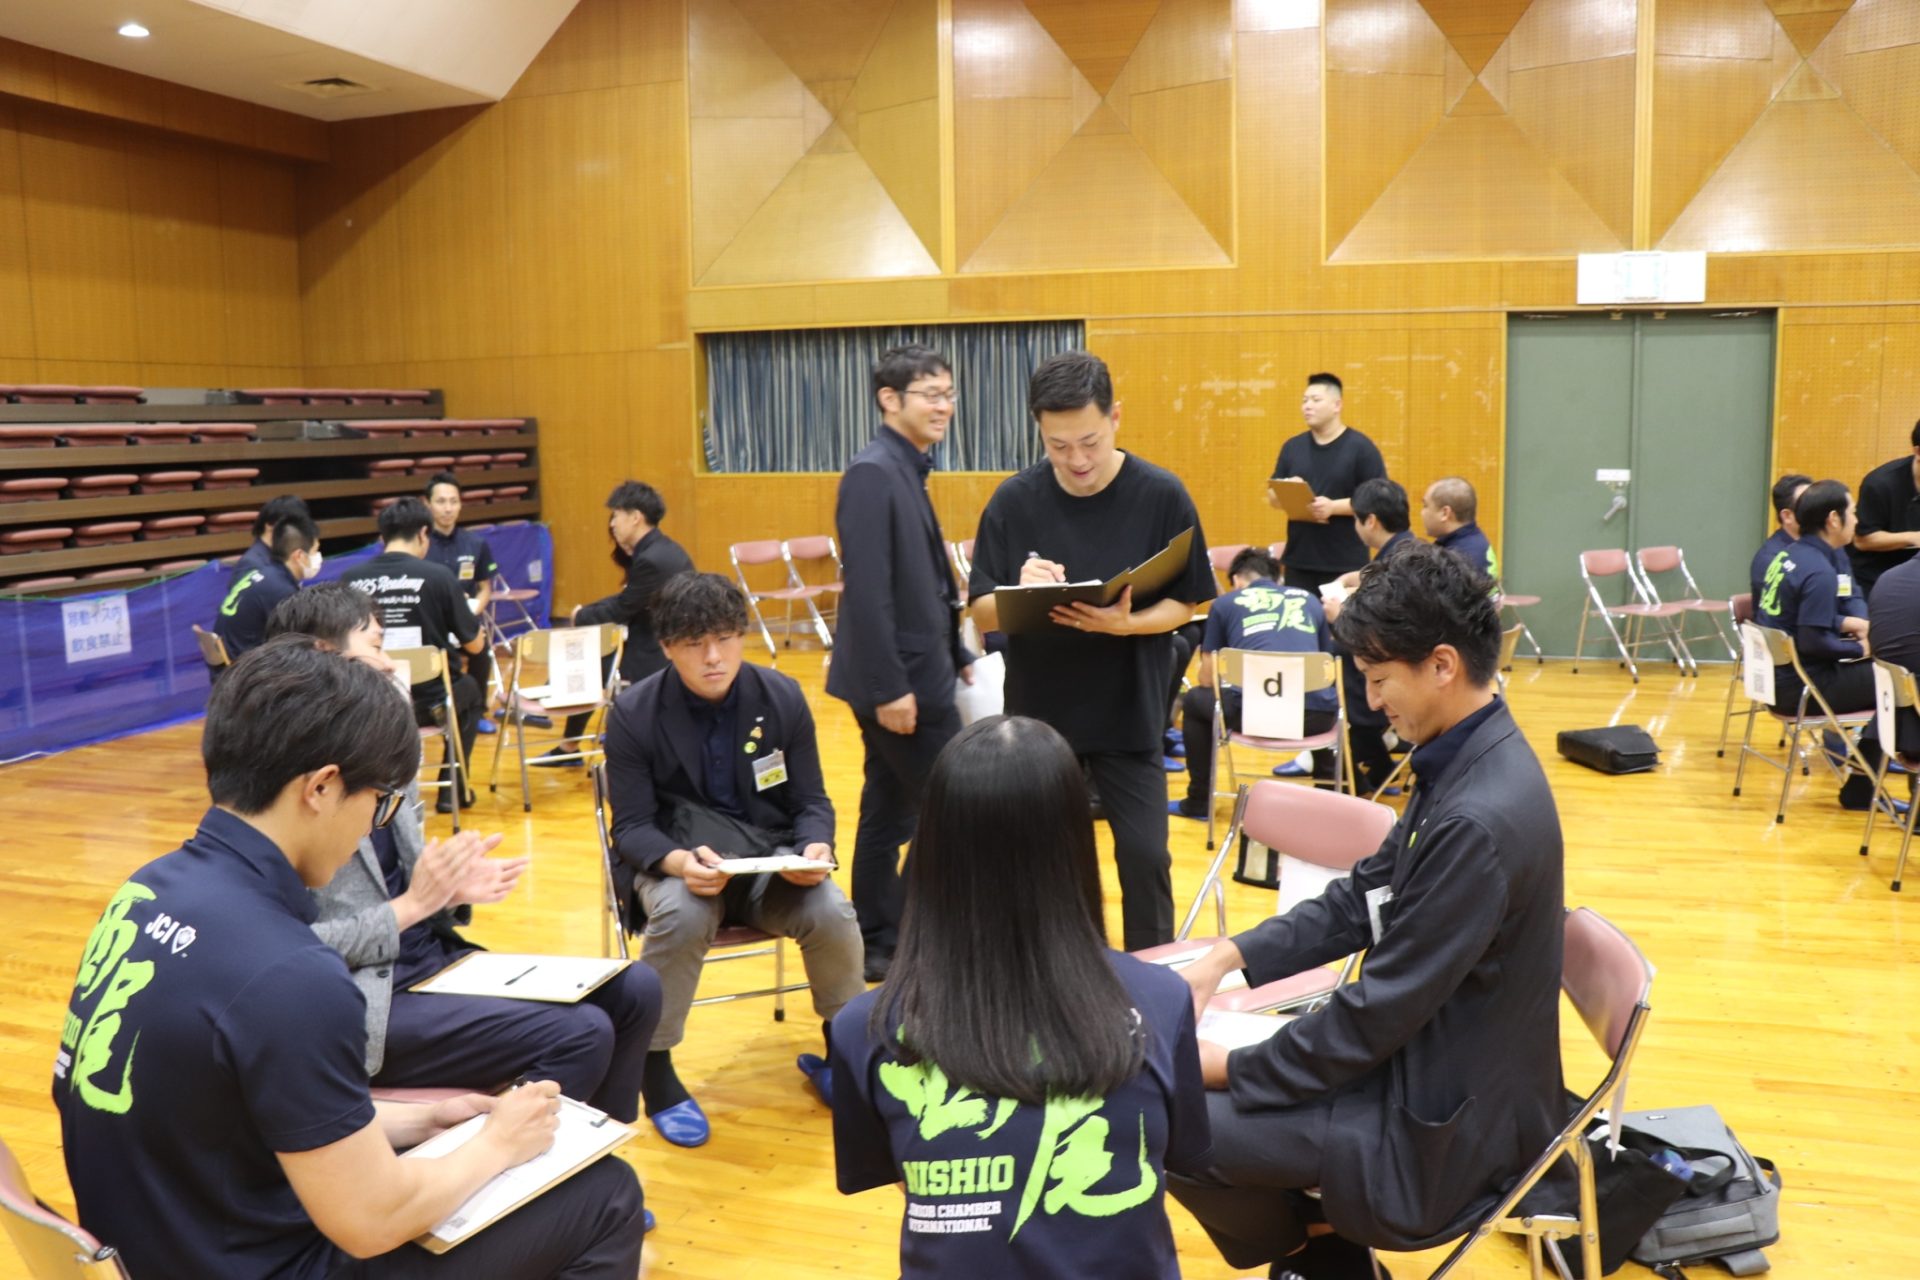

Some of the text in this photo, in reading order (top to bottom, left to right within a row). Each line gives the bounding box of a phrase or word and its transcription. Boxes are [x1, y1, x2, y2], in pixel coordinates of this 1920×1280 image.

[72, 633, 124, 653] 飲食禁止
[1263, 672, 1283, 697] d
[144, 913, 180, 944] JCI
[937, 1201, 1002, 1218] CHAMBER
